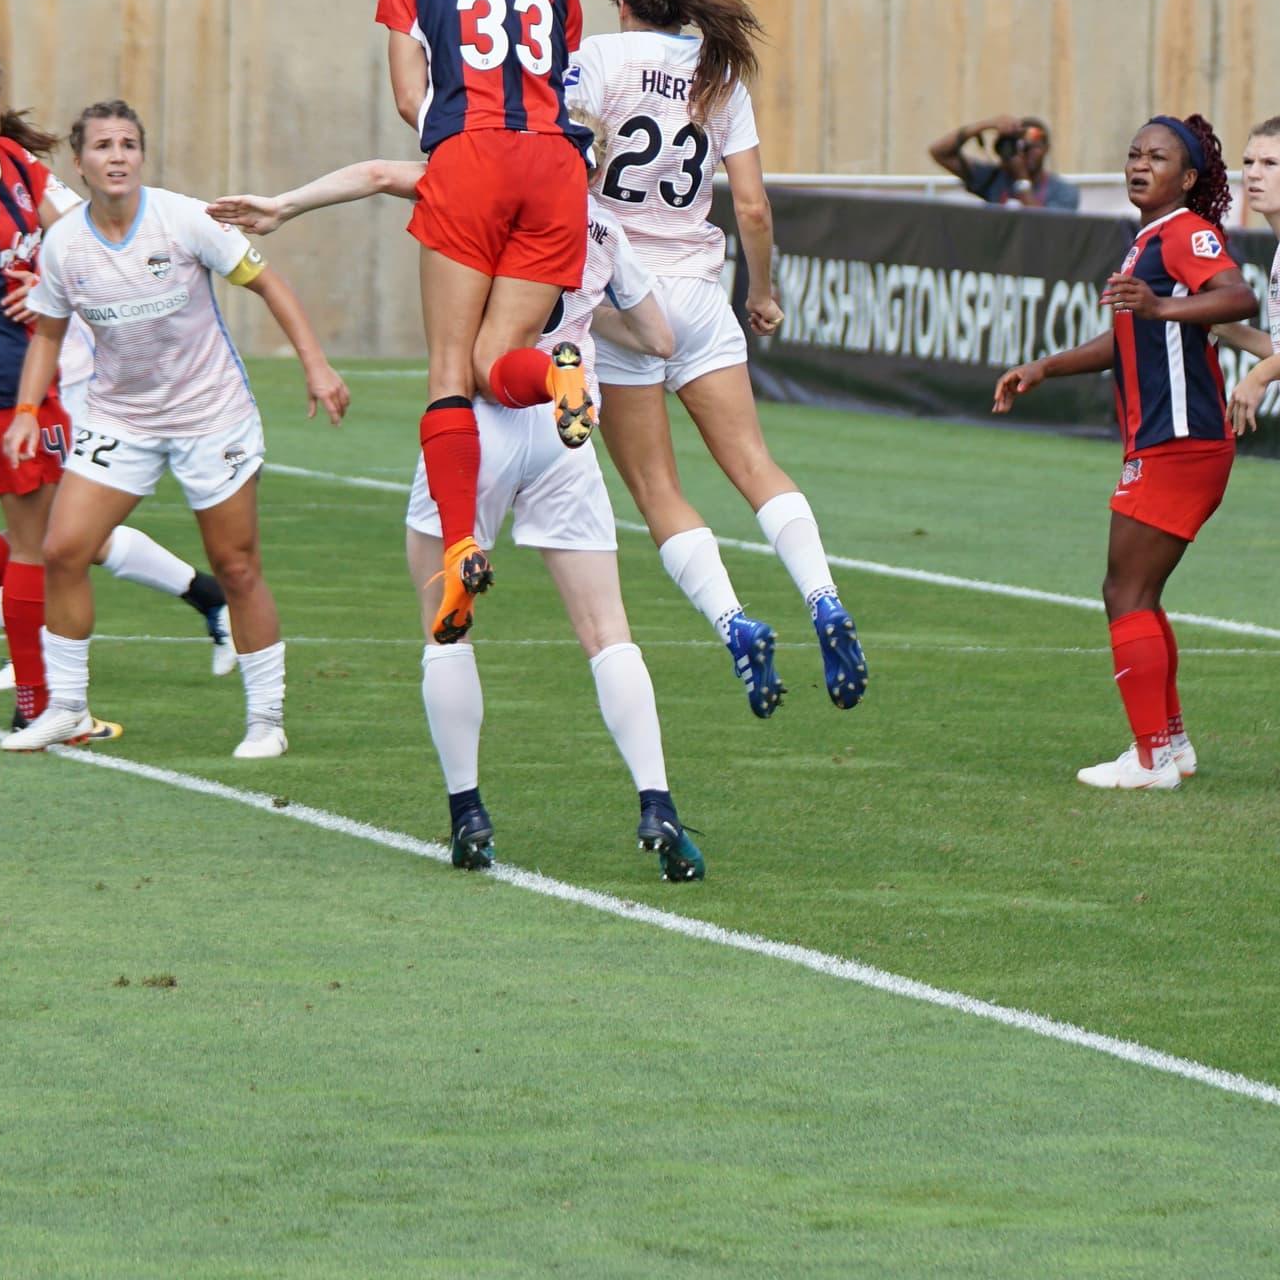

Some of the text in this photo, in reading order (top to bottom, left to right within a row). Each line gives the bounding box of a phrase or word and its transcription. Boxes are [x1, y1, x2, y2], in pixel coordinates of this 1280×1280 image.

[601, 114, 709, 209] 23
[120, 289, 189, 318] Compass
[74, 428, 119, 468] 22
